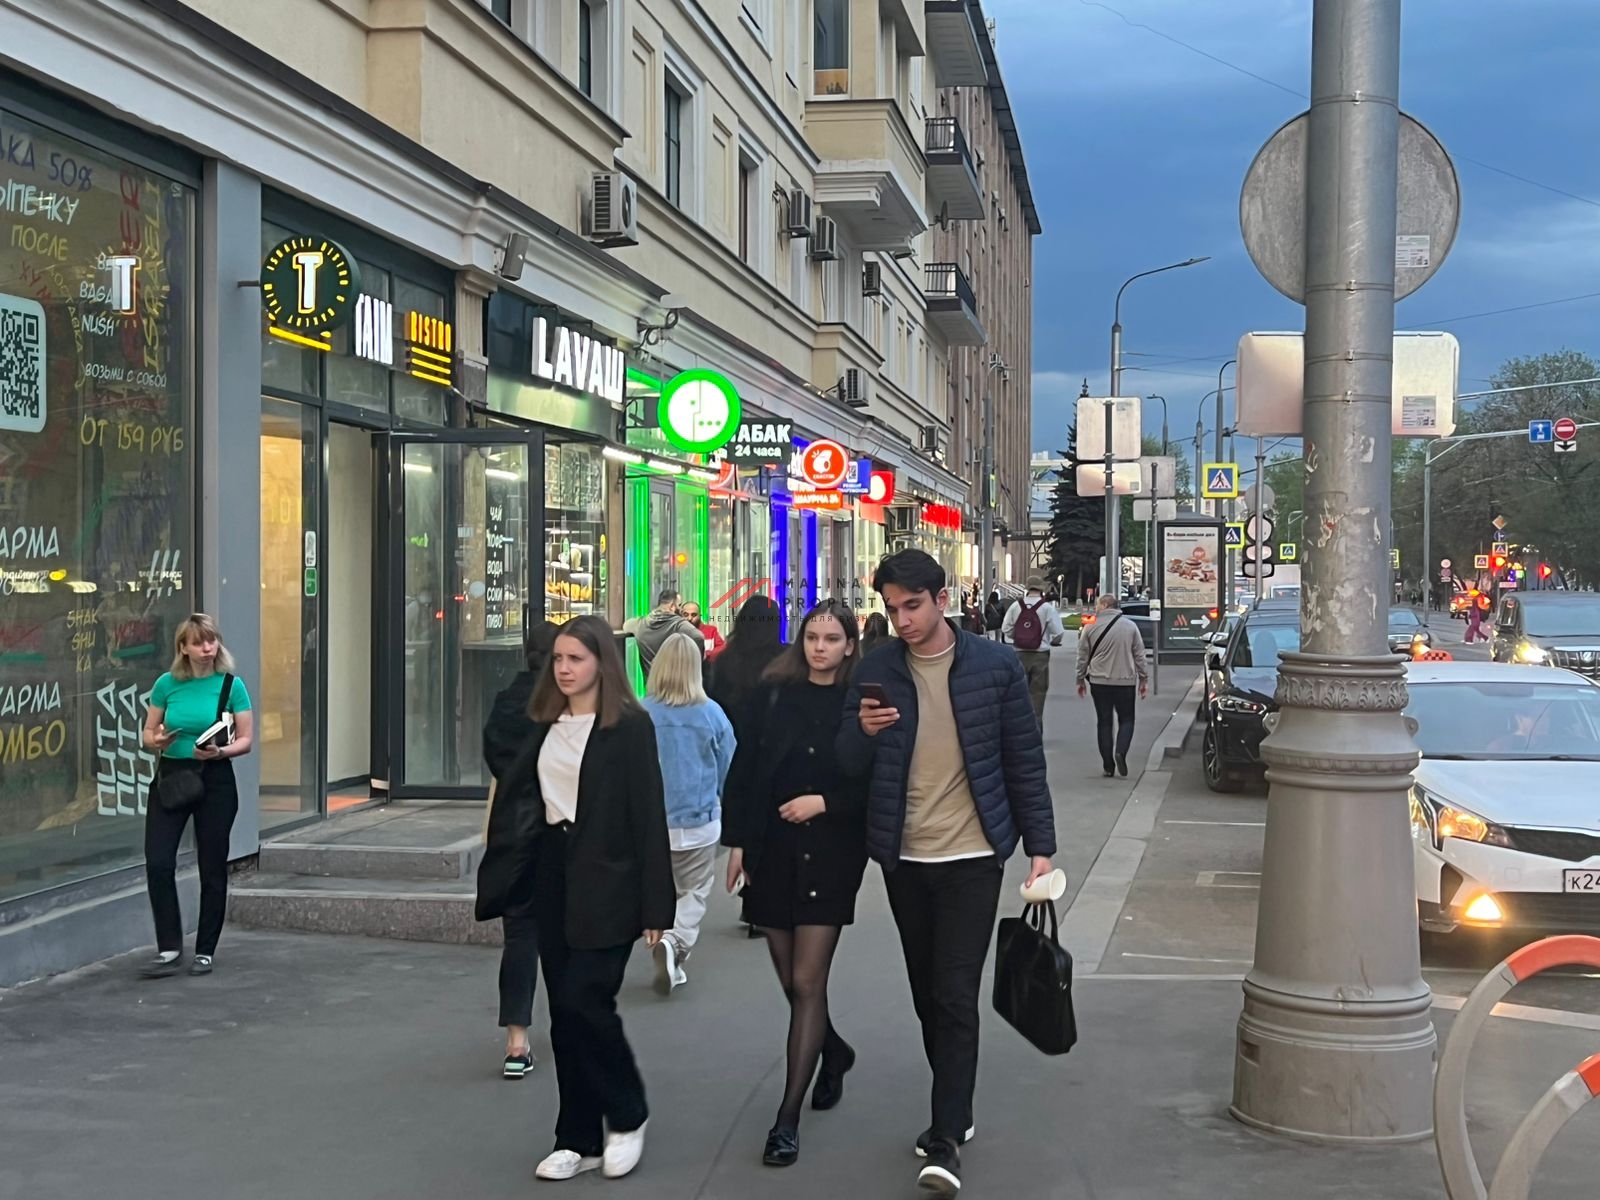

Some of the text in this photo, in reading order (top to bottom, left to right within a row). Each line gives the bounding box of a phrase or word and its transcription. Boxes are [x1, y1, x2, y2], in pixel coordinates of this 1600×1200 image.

[0, 128, 36, 171] КА
[11, 225, 68, 260] ПОСЛЕ
[81, 314, 115, 336] NUSH
[410, 311, 451, 353] BISTRO
[81, 413, 185, 456] ОТ 159 РУБ
[731, 423, 791, 443] АБАК
[735, 444, 750, 457] 24
[490, 504, 502, 521] ЧАЙ
[486, 560, 503, 578] ВОДА
[486, 587, 503, 601] СОКИ
[486, 614, 503, 628] ПИВО
[0, 681, 61, 717] АРМА
